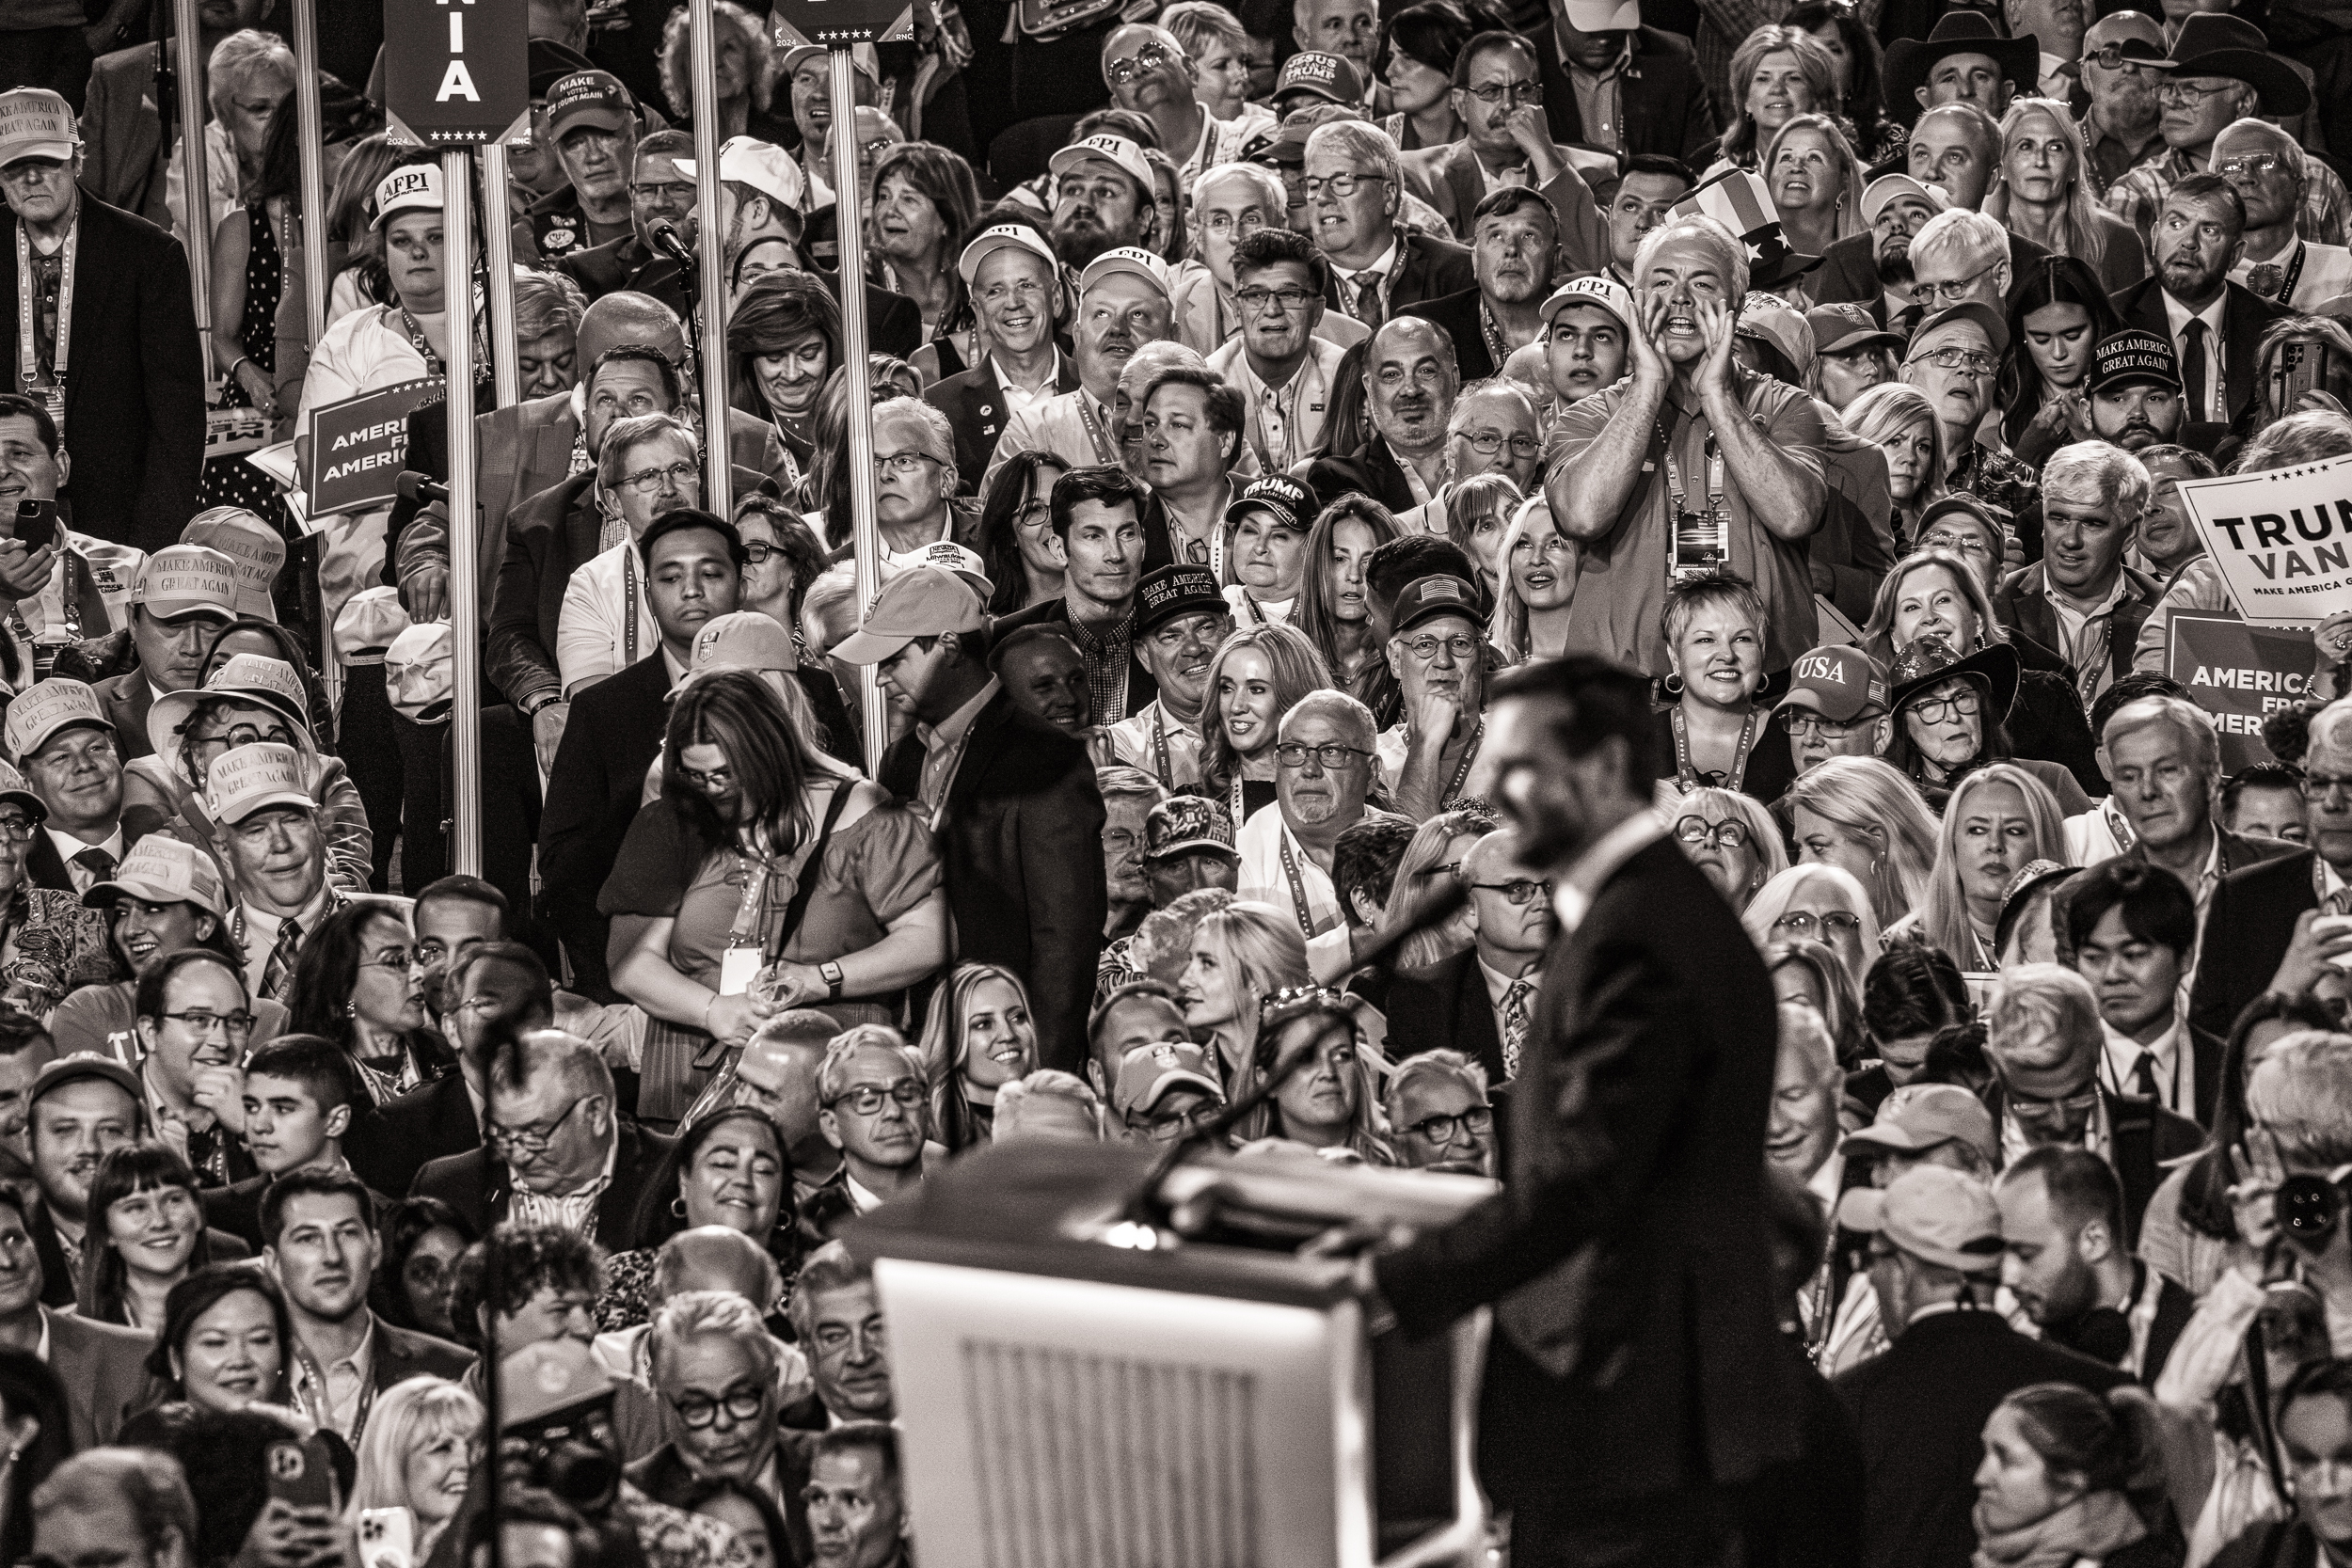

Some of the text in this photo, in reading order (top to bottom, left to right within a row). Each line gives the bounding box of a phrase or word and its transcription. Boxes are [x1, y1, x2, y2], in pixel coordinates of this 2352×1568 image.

[428, 0, 481, 102] IA
[1287, 54, 1337, 69] JESUS
[1286, 67, 1335, 79] TRUMP
[559, 76, 595, 92] MAKE
[579, 91, 602, 100] AGAIN
[14, 101, 60, 115] AMERICA
[27, 119, 56, 132] AGAIN
[387, 137, 408, 146] 2024
[384, 173, 428, 201] AFPI
[2096, 339, 2173, 361] MAKE AMERICA
[2102, 355, 2168, 374] GREAT AGAIN
[1243, 478, 1305, 500] TRUMP
[156, 558, 191, 573] MAKE
[191, 558, 235, 578] AMERICA
[200, 578, 230, 595] AGAIN
[1142, 573, 1213, 601] MAKE AMERICA
[2253, 587, 2284, 595] MAKE
[2288, 580, 2342, 594] AMERICA
[1149, 588, 1178, 610] GREAT
[1798, 657, 1846, 685] USA
[2191, 665, 2310, 694] AMERIC
